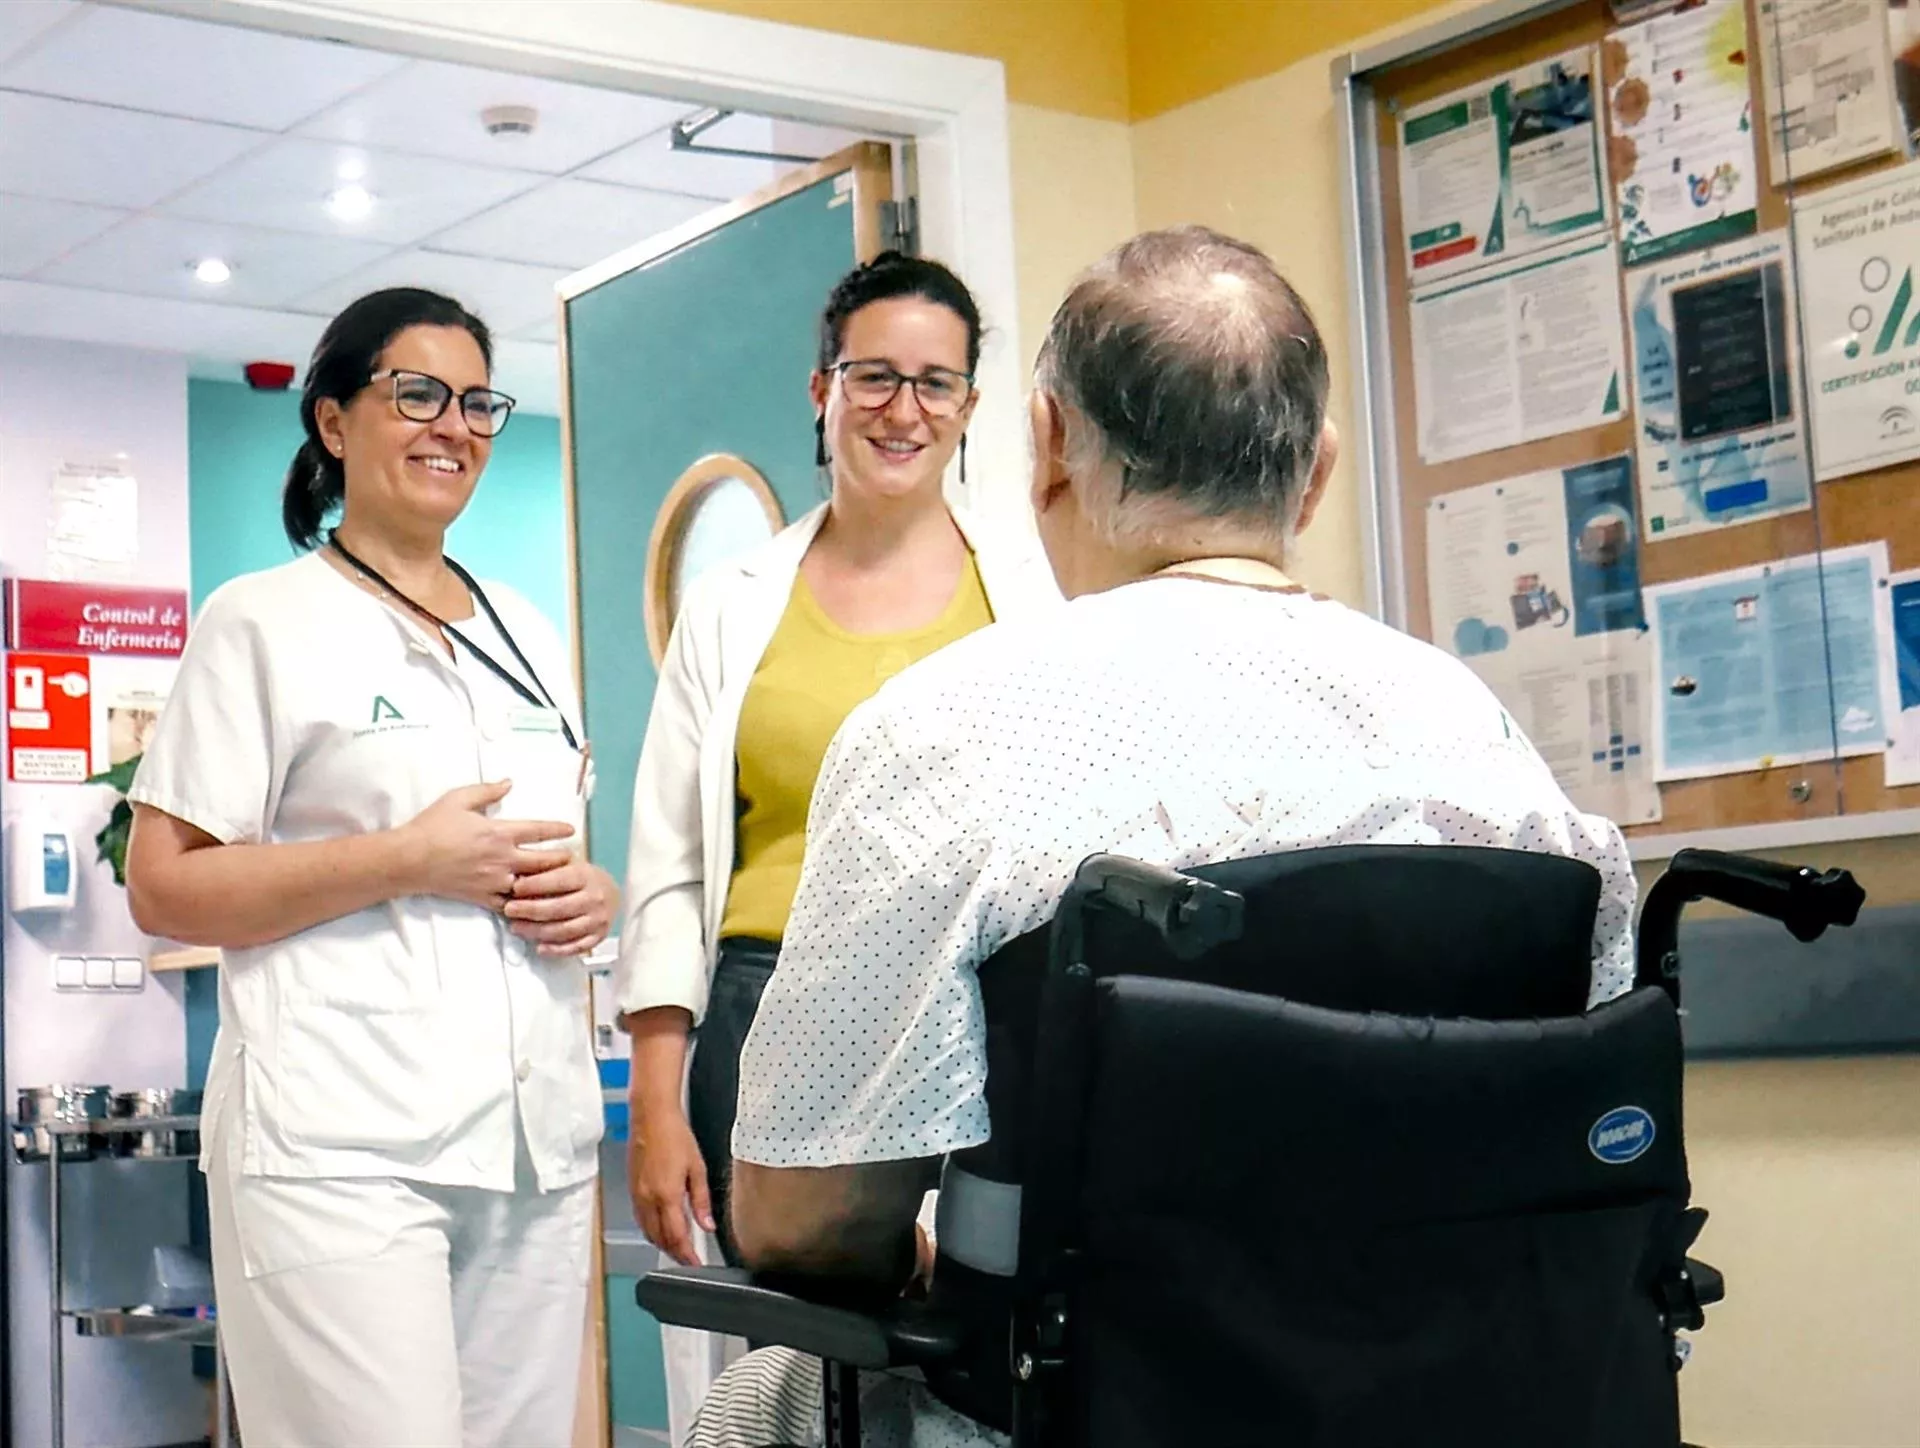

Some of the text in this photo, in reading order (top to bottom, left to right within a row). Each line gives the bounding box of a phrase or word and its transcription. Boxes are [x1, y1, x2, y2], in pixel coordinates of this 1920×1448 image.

[1821, 205, 1868, 229] Agencia
[1872, 198, 1887, 212] de
[1812, 225, 1866, 250] Sanitaria
[1870, 218, 1885, 232] de
[1821, 361, 1905, 393] CERTIFICACIÓN
[82, 603, 181, 626] Control de
[77, 627, 181, 652] Enfermería
